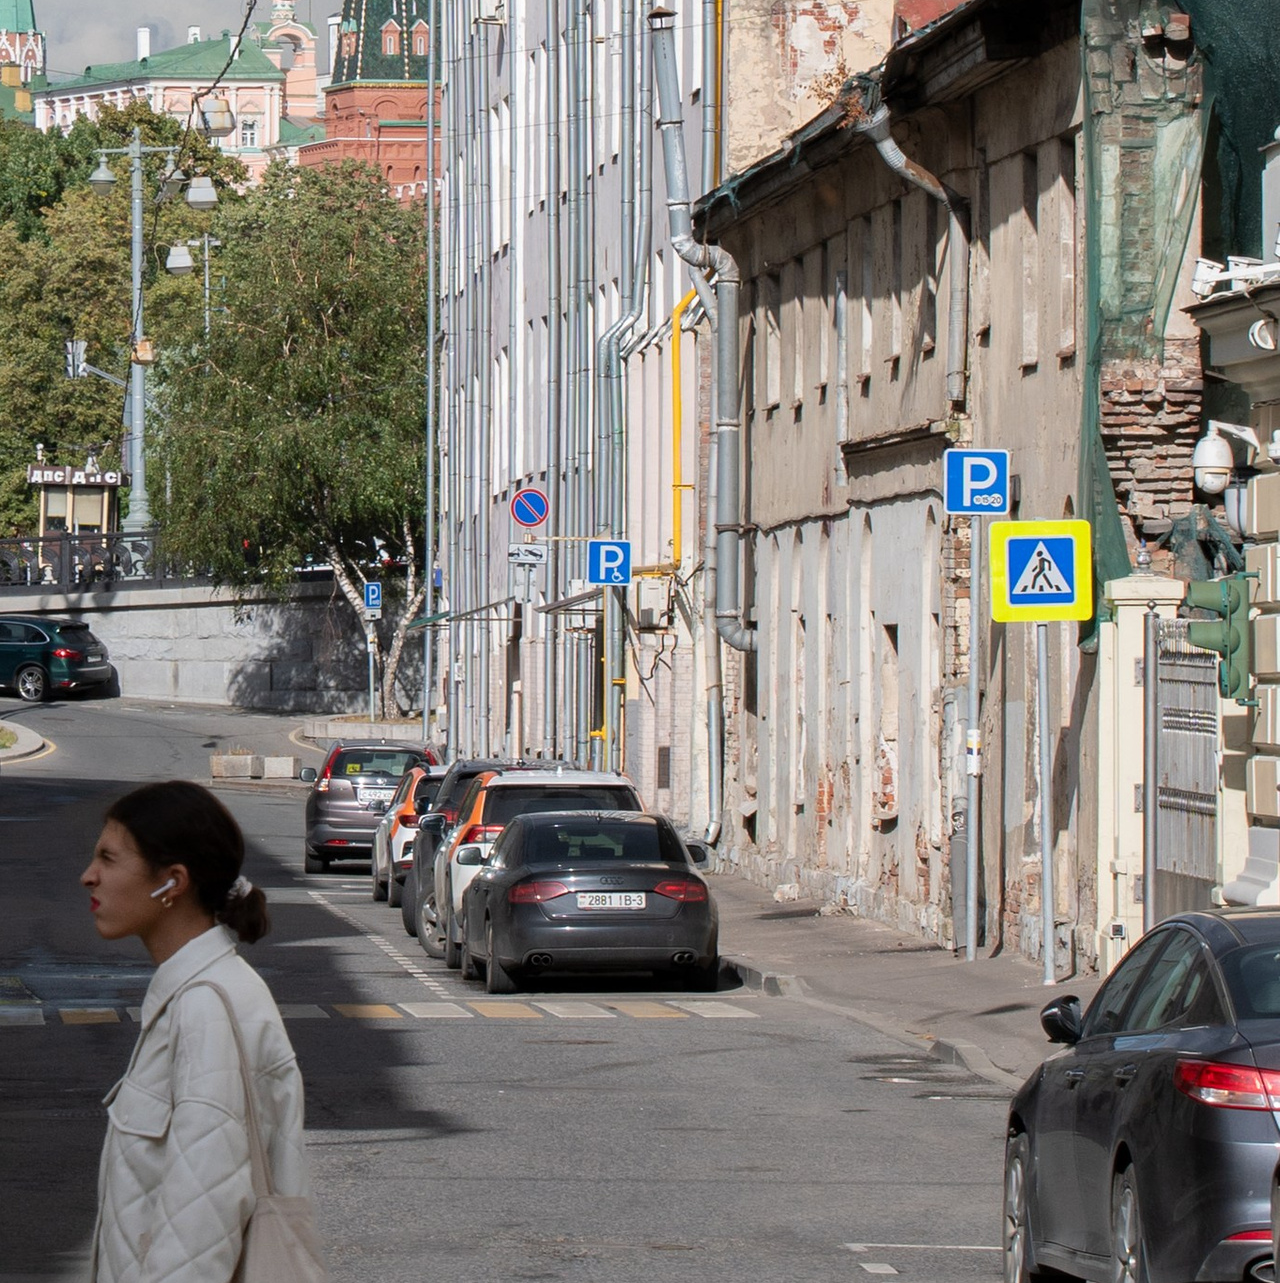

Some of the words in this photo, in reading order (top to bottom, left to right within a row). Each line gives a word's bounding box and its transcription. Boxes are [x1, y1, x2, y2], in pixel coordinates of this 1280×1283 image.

[31, 470, 65, 483] ДПС
[963, 457, 998, 507] P
[991, 496, 1002, 505] 20
[600, 545, 624, 580] P
[369, 586, 379, 605] P
[588, 895, 612, 906] 2881
[619, 895, 643, 906] IB-3
